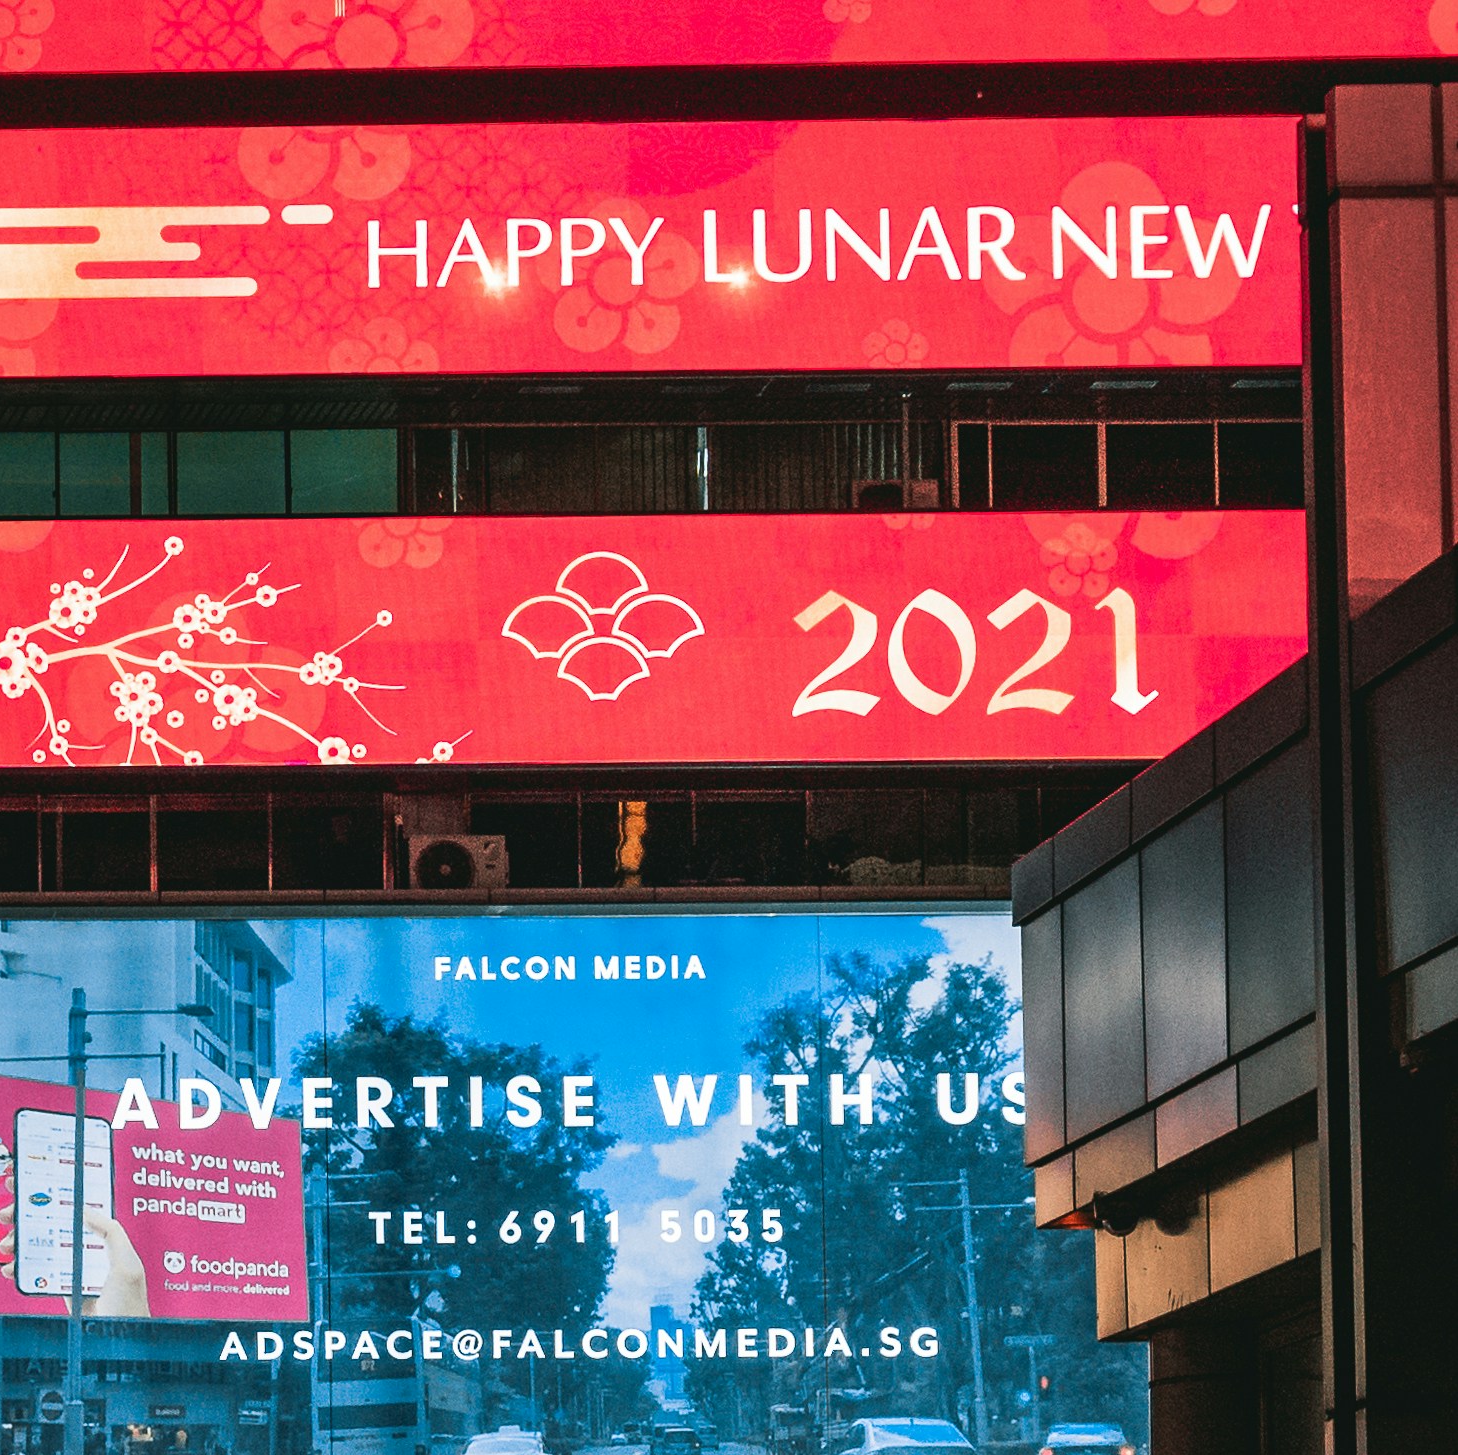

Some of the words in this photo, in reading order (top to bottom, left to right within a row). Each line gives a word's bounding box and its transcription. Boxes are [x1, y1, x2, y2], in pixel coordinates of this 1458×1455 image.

[365, 216, 666, 289] HAPPY
[701, 205, 1026, 283] LUNAR
[1050, 203, 1272, 280] NEW
[791, 587, 1159, 718] 2021
[434, 956, 577, 982] FALCON
[594, 955, 706, 980] MEDIA
[111, 1075, 594, 1132] ADVERTISE
[652, 1073, 875, 1130] WITH
[936, 1072, 1027, 1127] US
[132, 1142, 185, 1165] what
[190, 1153, 228, 1171] you
[232, 1157, 284, 1179] want,
[132, 1168, 229, 1194] delivered
[235, 1180, 277, 1199] with
[133, 1197, 244, 1221] pandamart
[369, 1211, 477, 1245] TEL:
[497, 1209, 622, 1245] 6911
[660, 1208, 785, 1244] 5035
[190, 1254, 289, 1280] foodpanda
[164, 1280, 190, 1292] food
[191, 1282, 211, 1292] and
[243, 1283, 290, 1296] delivered
[219, 1327, 941, 1363] ADSPACE@FALCONMEDIA.SG
